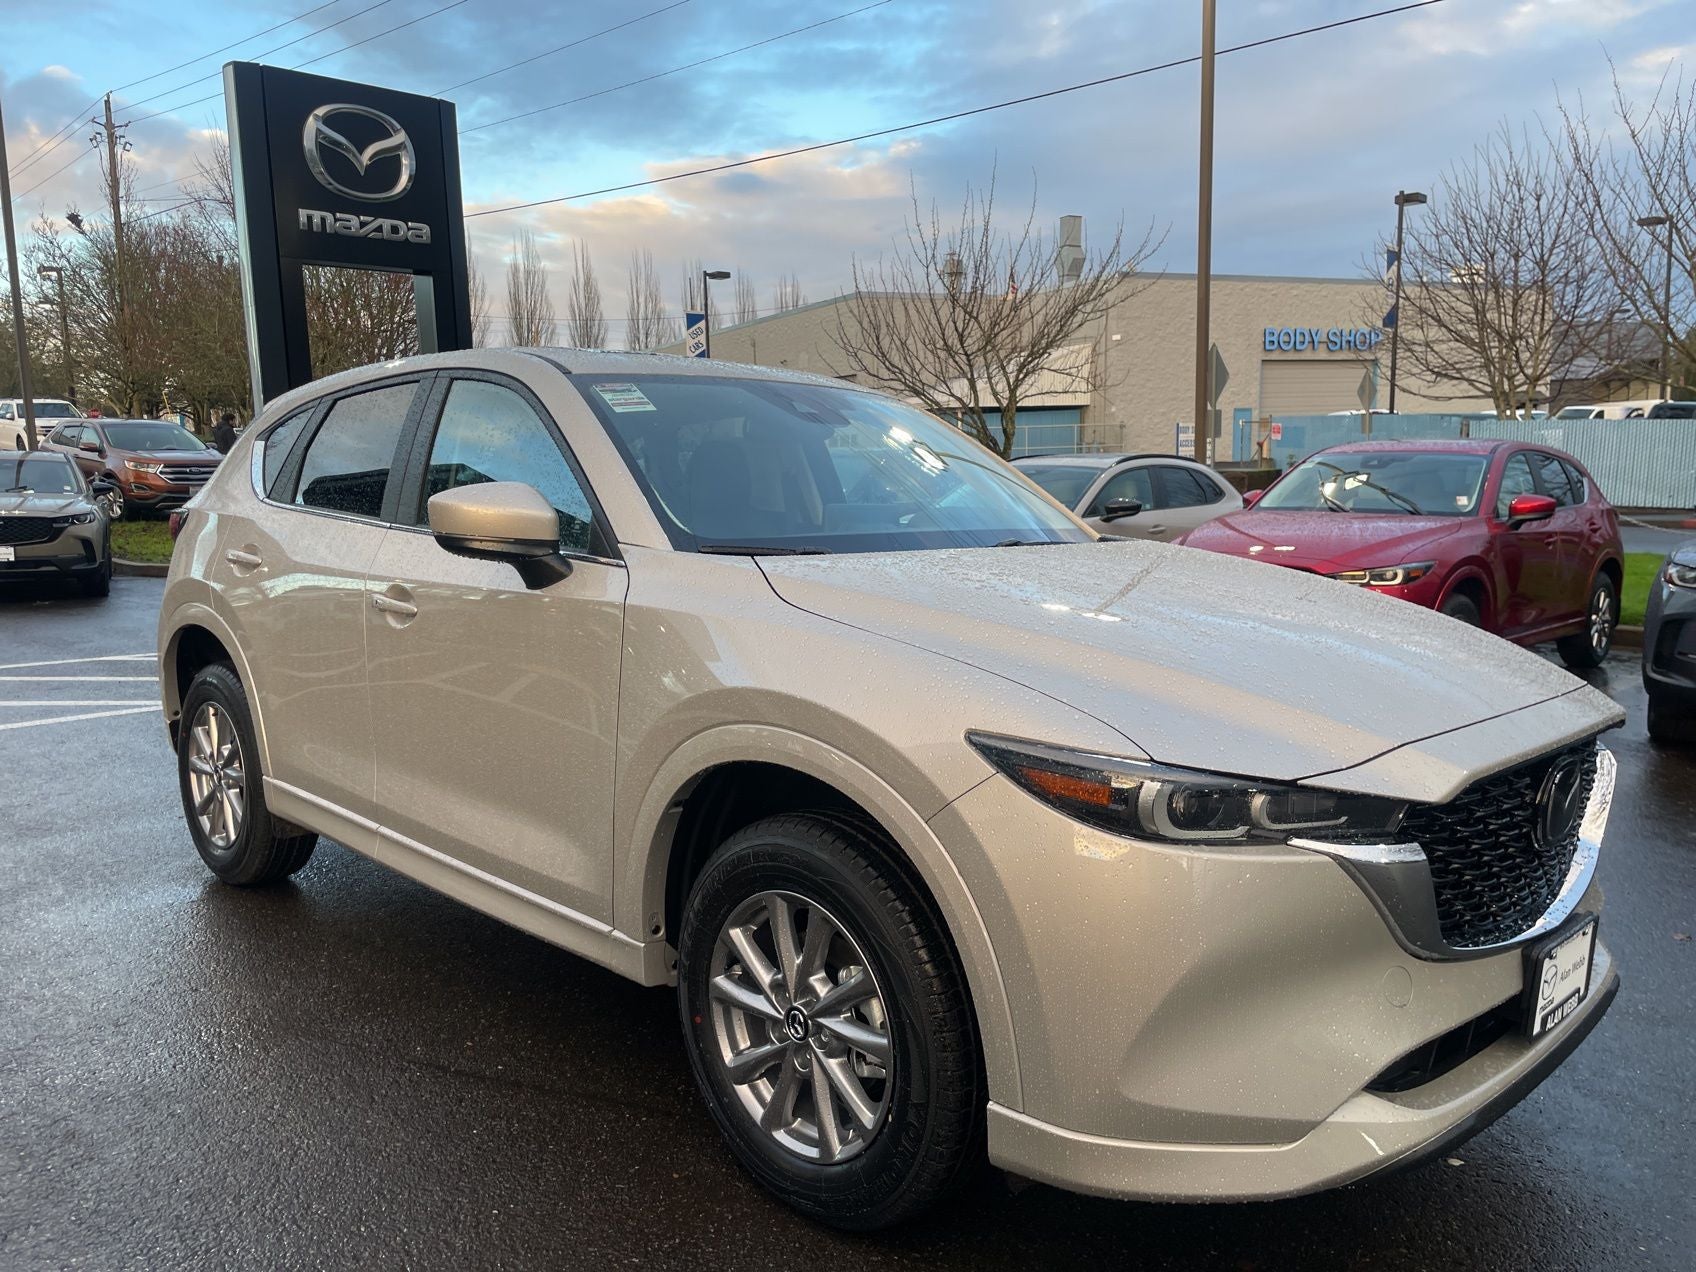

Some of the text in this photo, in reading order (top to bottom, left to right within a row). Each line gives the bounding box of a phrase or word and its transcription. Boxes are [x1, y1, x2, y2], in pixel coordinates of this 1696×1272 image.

[688, 326, 704, 340] USED
[1264, 327, 1382, 352] BODY SHOP
[689, 340, 704, 354] CARS
[1560, 956, 1586, 982] Alan Webb
[1545, 992, 1579, 1031] ALAN WEBB
